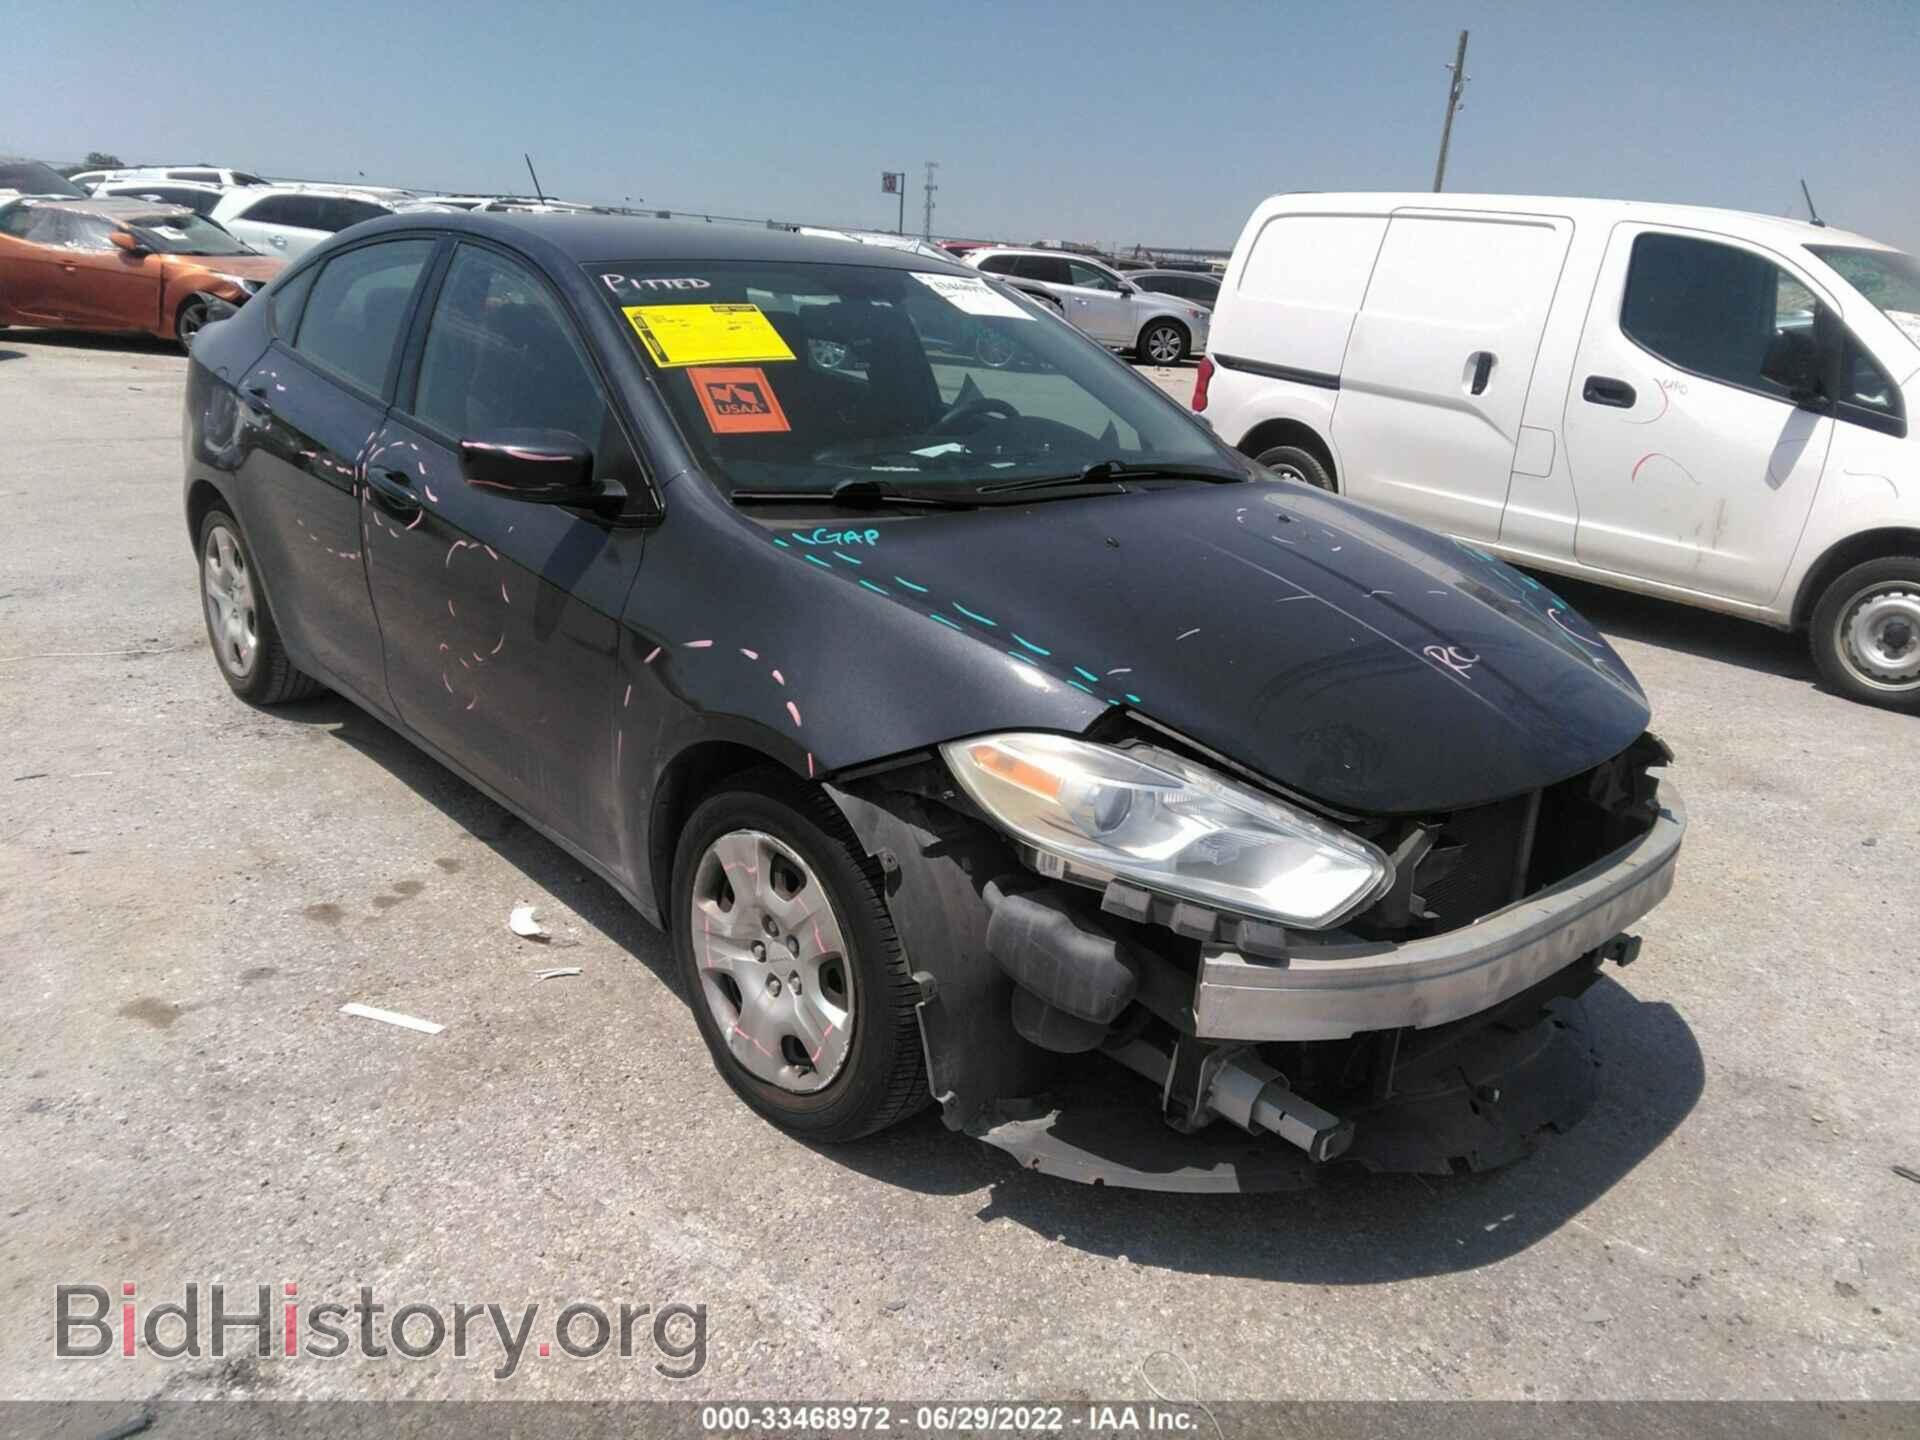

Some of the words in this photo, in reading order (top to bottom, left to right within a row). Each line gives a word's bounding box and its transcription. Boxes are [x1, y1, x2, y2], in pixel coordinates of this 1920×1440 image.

[600, 273, 711, 293] PITTED
[717, 402, 763, 414] USAA
[812, 527, 880, 546] GAP
[1423, 645, 1481, 680] RC
